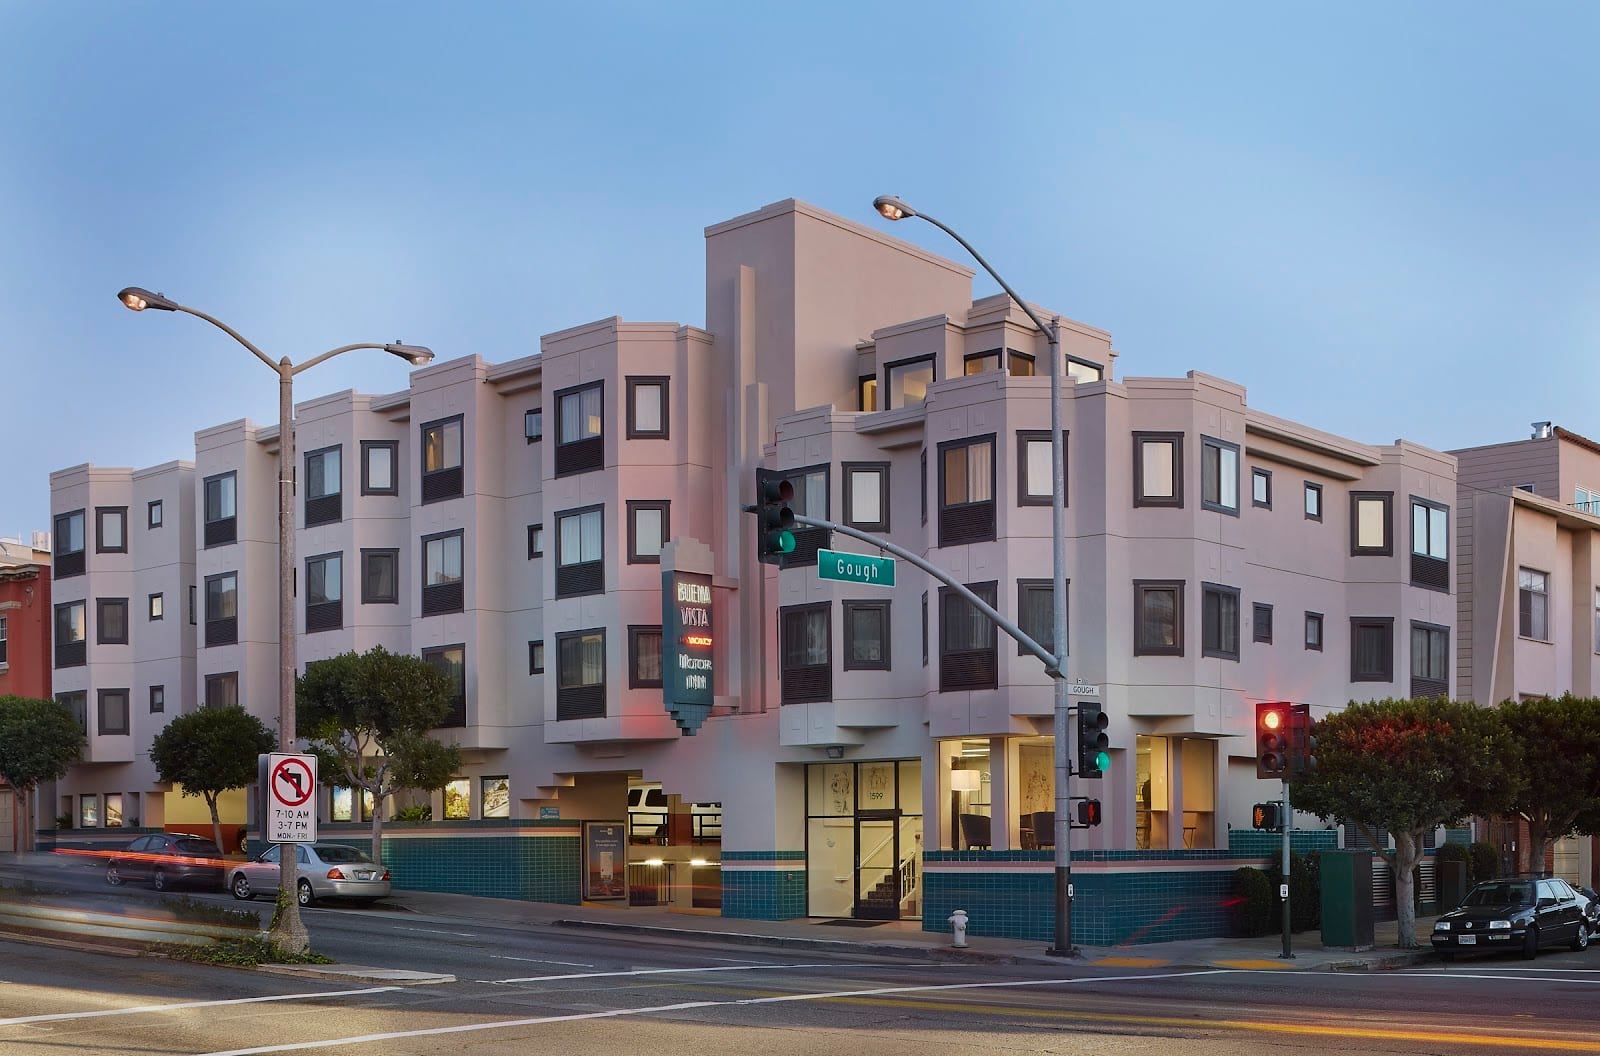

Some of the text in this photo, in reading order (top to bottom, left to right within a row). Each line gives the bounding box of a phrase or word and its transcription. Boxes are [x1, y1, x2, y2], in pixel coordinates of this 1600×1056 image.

[837, 559, 878, 582] Gough
[677, 582, 712, 604] BUENA
[681, 607, 709, 627] VISTA
[679, 653, 713, 671] MOTOR
[1073, 685, 1094, 694] GOUGH
[275, 809, 309, 819] 7-10 AM
[278, 821, 308, 830] 3-7 PM
